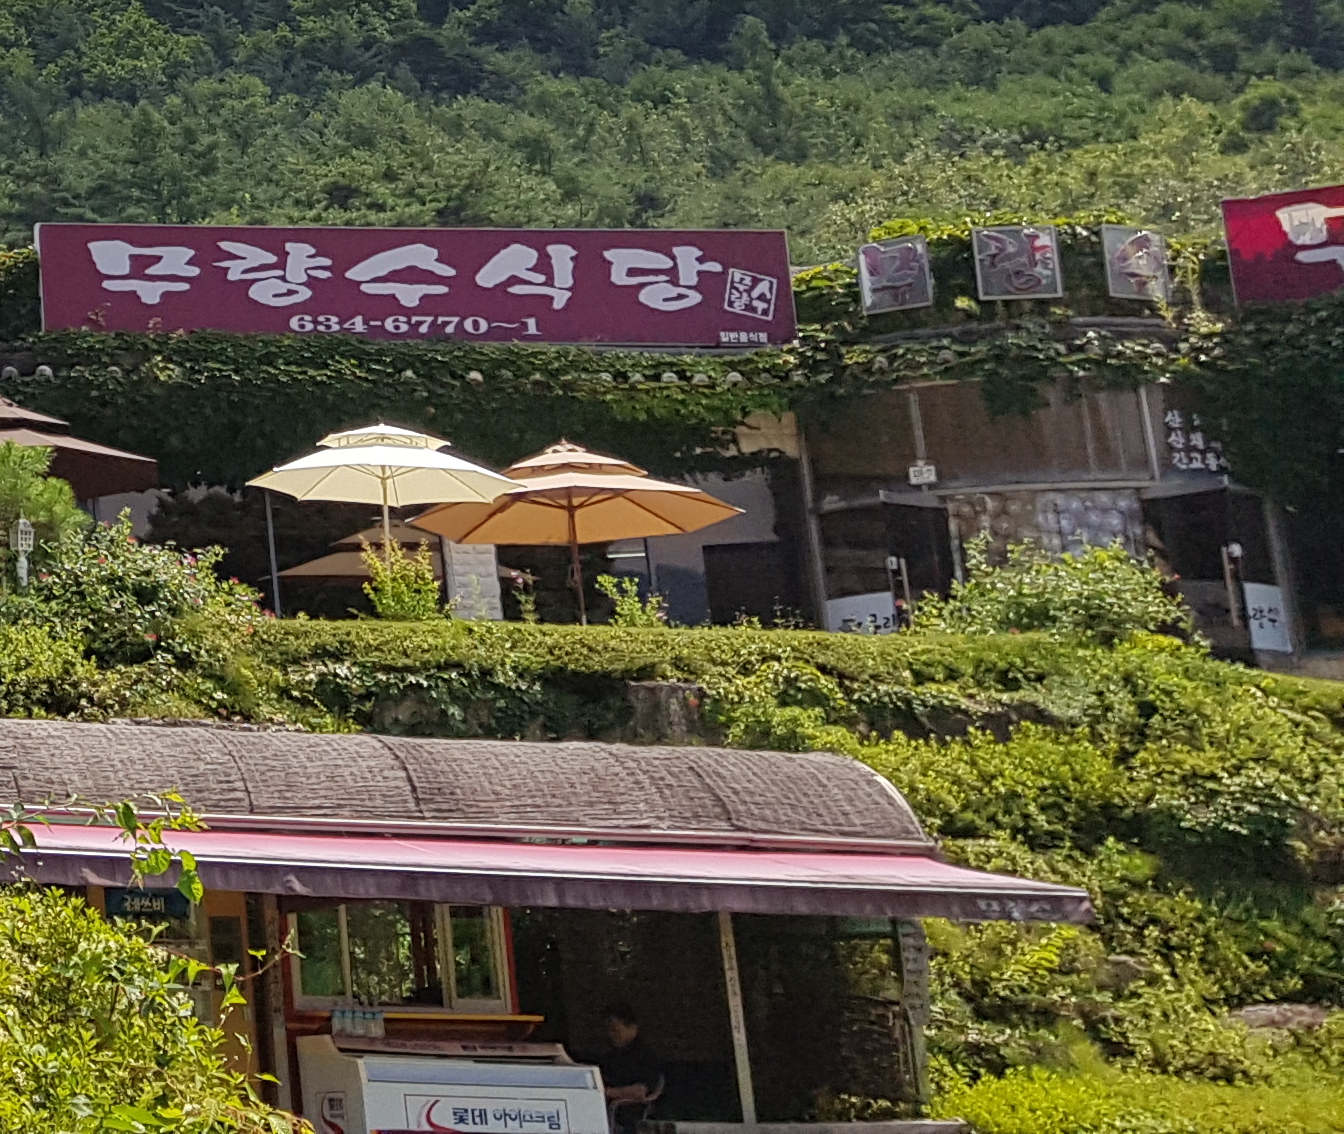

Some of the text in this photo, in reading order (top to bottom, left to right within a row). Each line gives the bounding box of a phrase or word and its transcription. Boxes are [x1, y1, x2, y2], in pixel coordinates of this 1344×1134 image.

[87, 240, 723, 311] 무량수식당
[289, 315, 543, 335] 634-6770~1
[452, 1107, 561, 1131] 롯데 아이스크림
